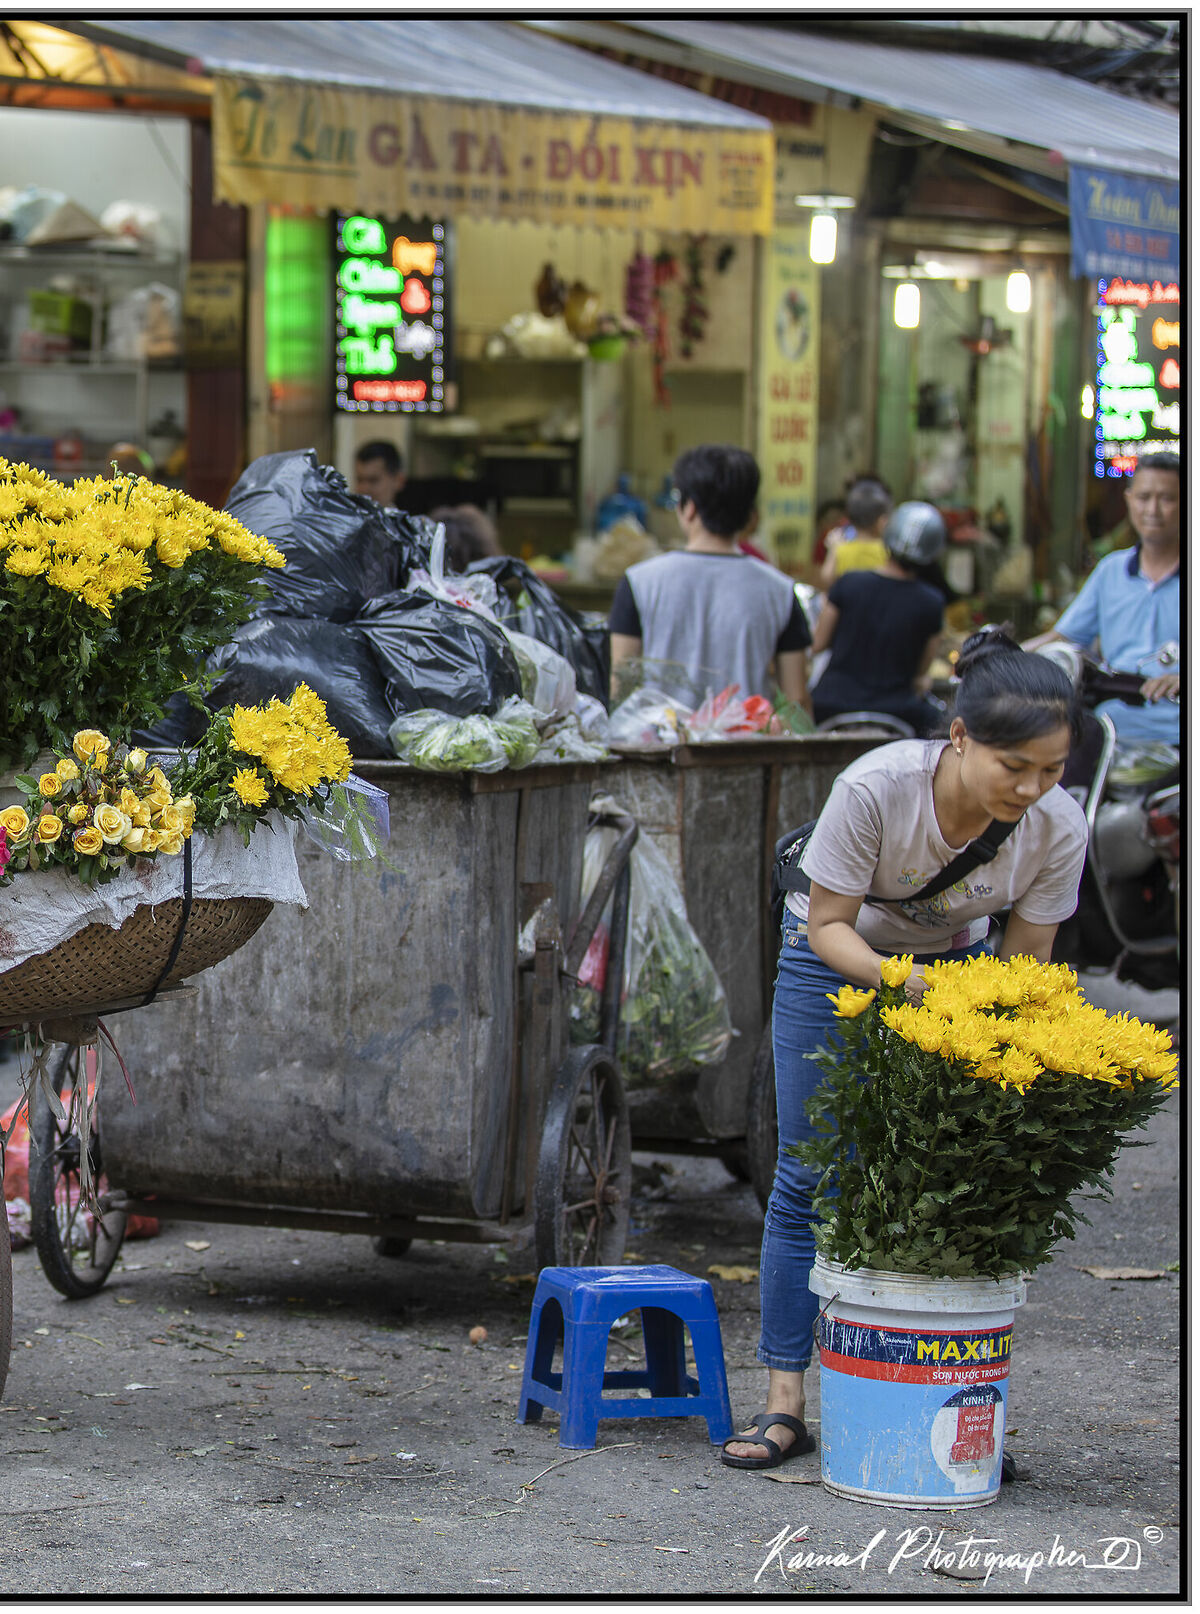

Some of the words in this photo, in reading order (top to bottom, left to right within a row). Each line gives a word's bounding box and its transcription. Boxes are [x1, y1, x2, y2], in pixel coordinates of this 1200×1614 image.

[367, 110, 438, 171] GÀ
[450, 129, 509, 178] TA
[981, 1367, 1001, 1378] TRONG
[963, 1395, 984, 1406] KINH
